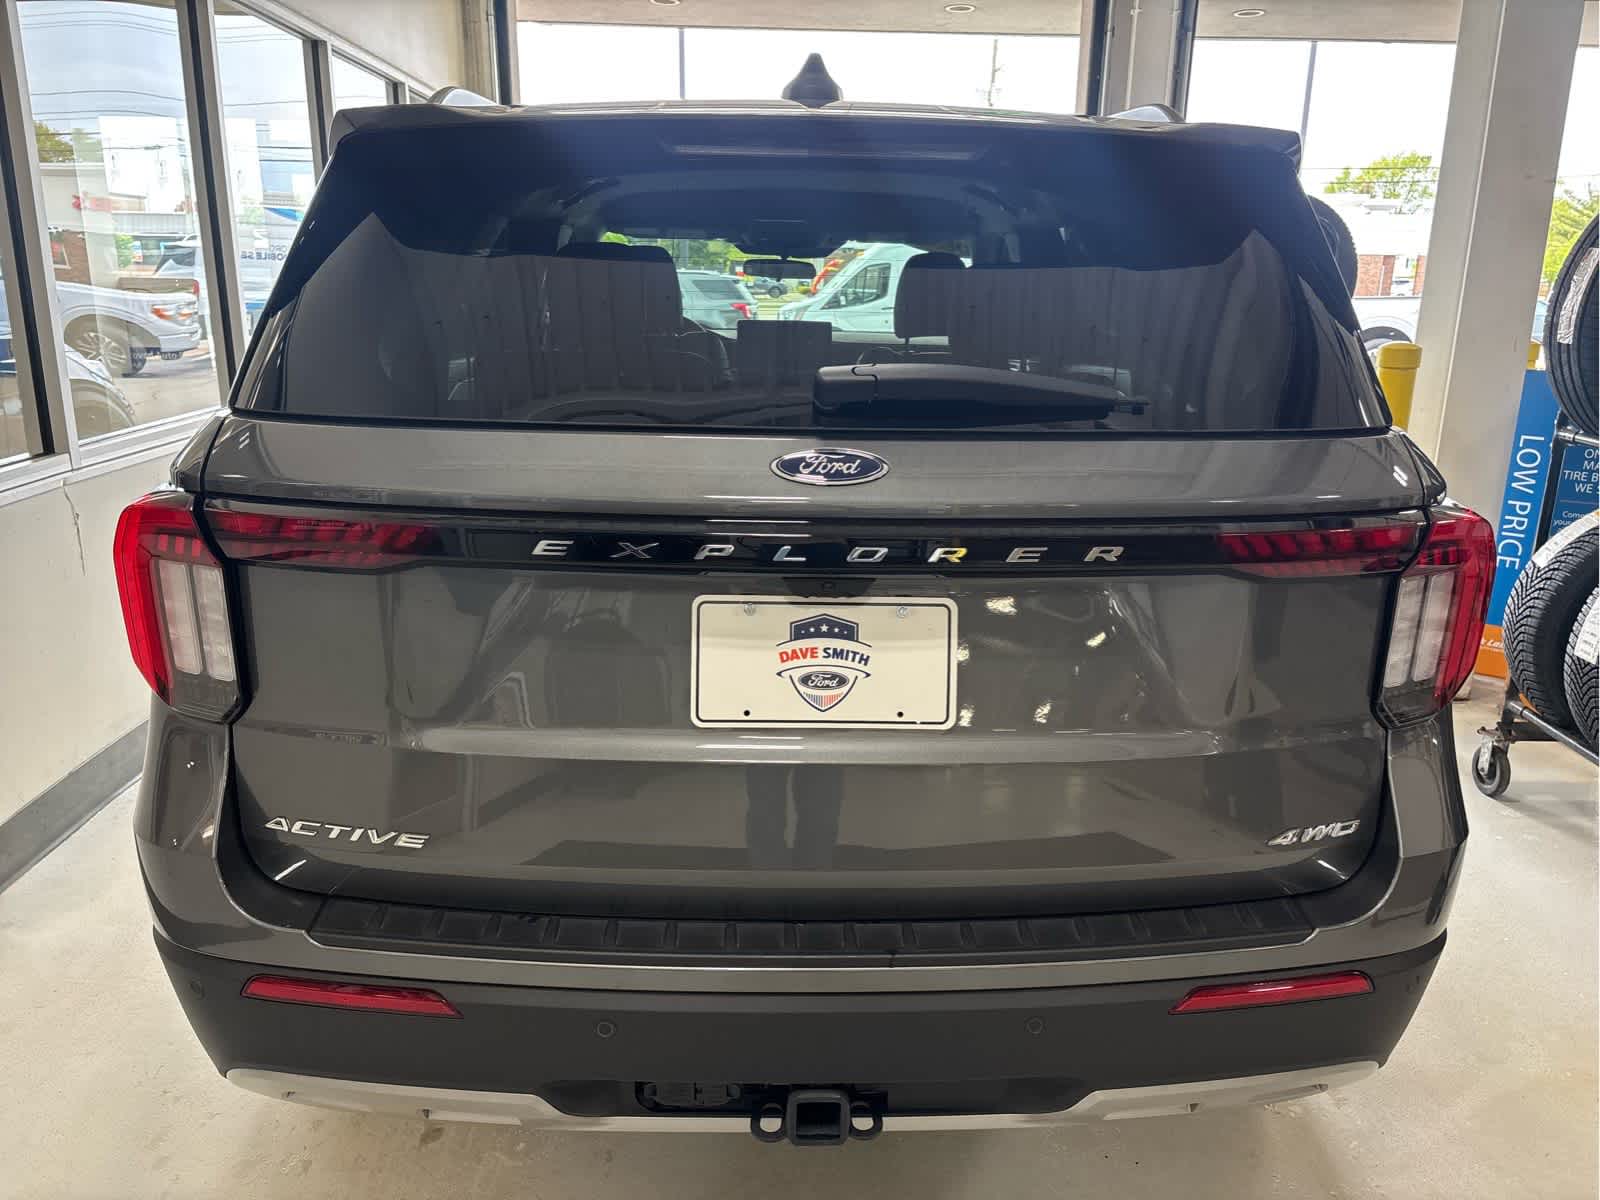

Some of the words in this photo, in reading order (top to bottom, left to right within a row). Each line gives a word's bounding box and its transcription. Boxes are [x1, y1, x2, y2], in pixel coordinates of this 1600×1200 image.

[800, 454, 861, 475] Ford
[1511, 434, 1545, 494] LOW
[1564, 470, 1588, 482] TIRE
[1575, 483, 1593, 494] WE
[1496, 500, 1535, 570] PRICE
[531, 539, 1124, 563] EXPLORER
[778, 647, 819, 664] DAVE
[822, 647, 870, 666] SMITH
[807, 673, 839, 688] Ford
[264, 816, 431, 849] ACTIVE
[1267, 819, 1361, 846] 4WD
